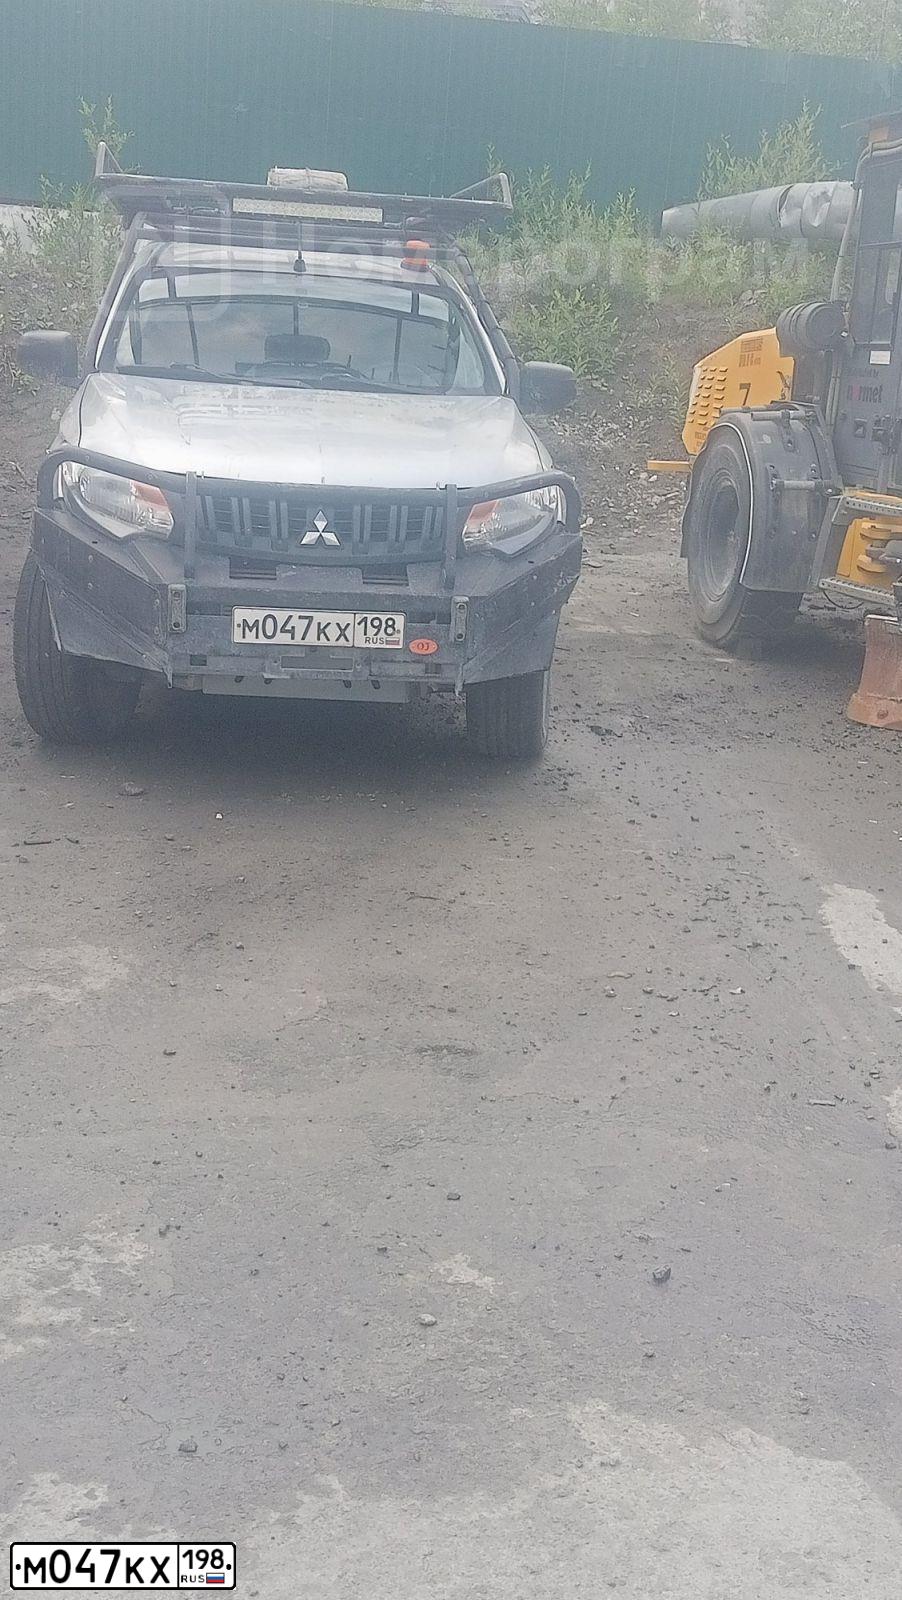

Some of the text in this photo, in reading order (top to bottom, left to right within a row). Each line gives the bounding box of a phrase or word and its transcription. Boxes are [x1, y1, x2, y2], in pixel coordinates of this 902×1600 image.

[739, 382, 751, 406] 7
[241, 613, 351, 643] М047КХ
[357, 615, 396, 637] 198
[364, 636, 385, 645] RUS
